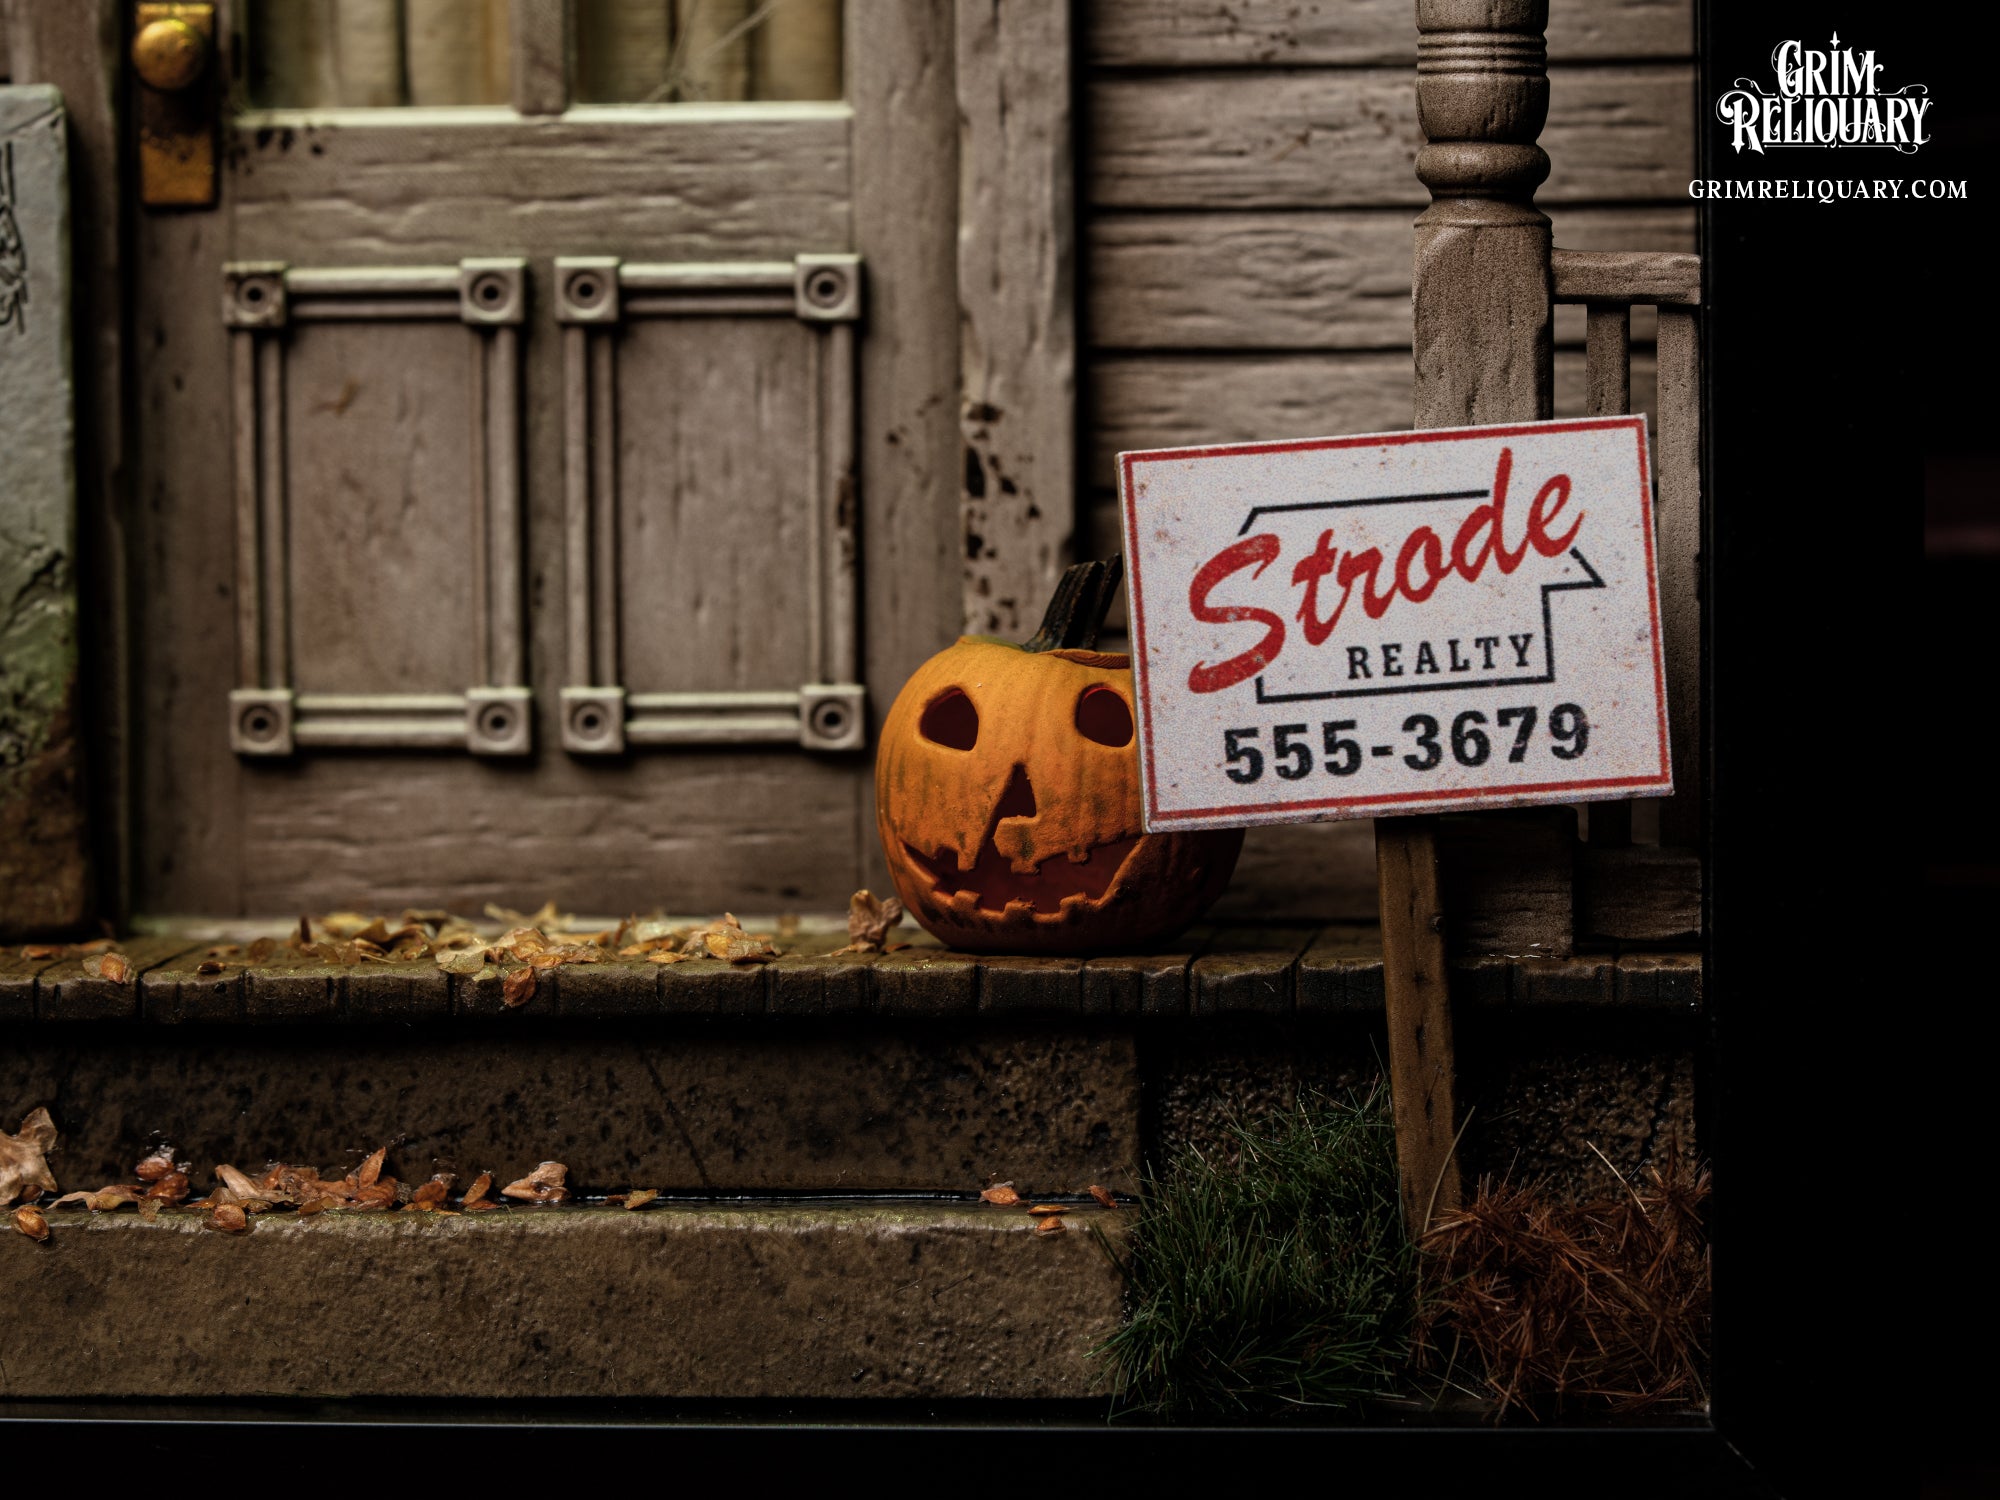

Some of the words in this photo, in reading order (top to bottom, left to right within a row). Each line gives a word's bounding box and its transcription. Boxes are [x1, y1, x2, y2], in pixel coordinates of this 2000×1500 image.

[1188, 447, 1586, 694] Strode
[1346, 632, 1535, 680] REALTY
[1223, 702, 1590, 785] 555-3679
